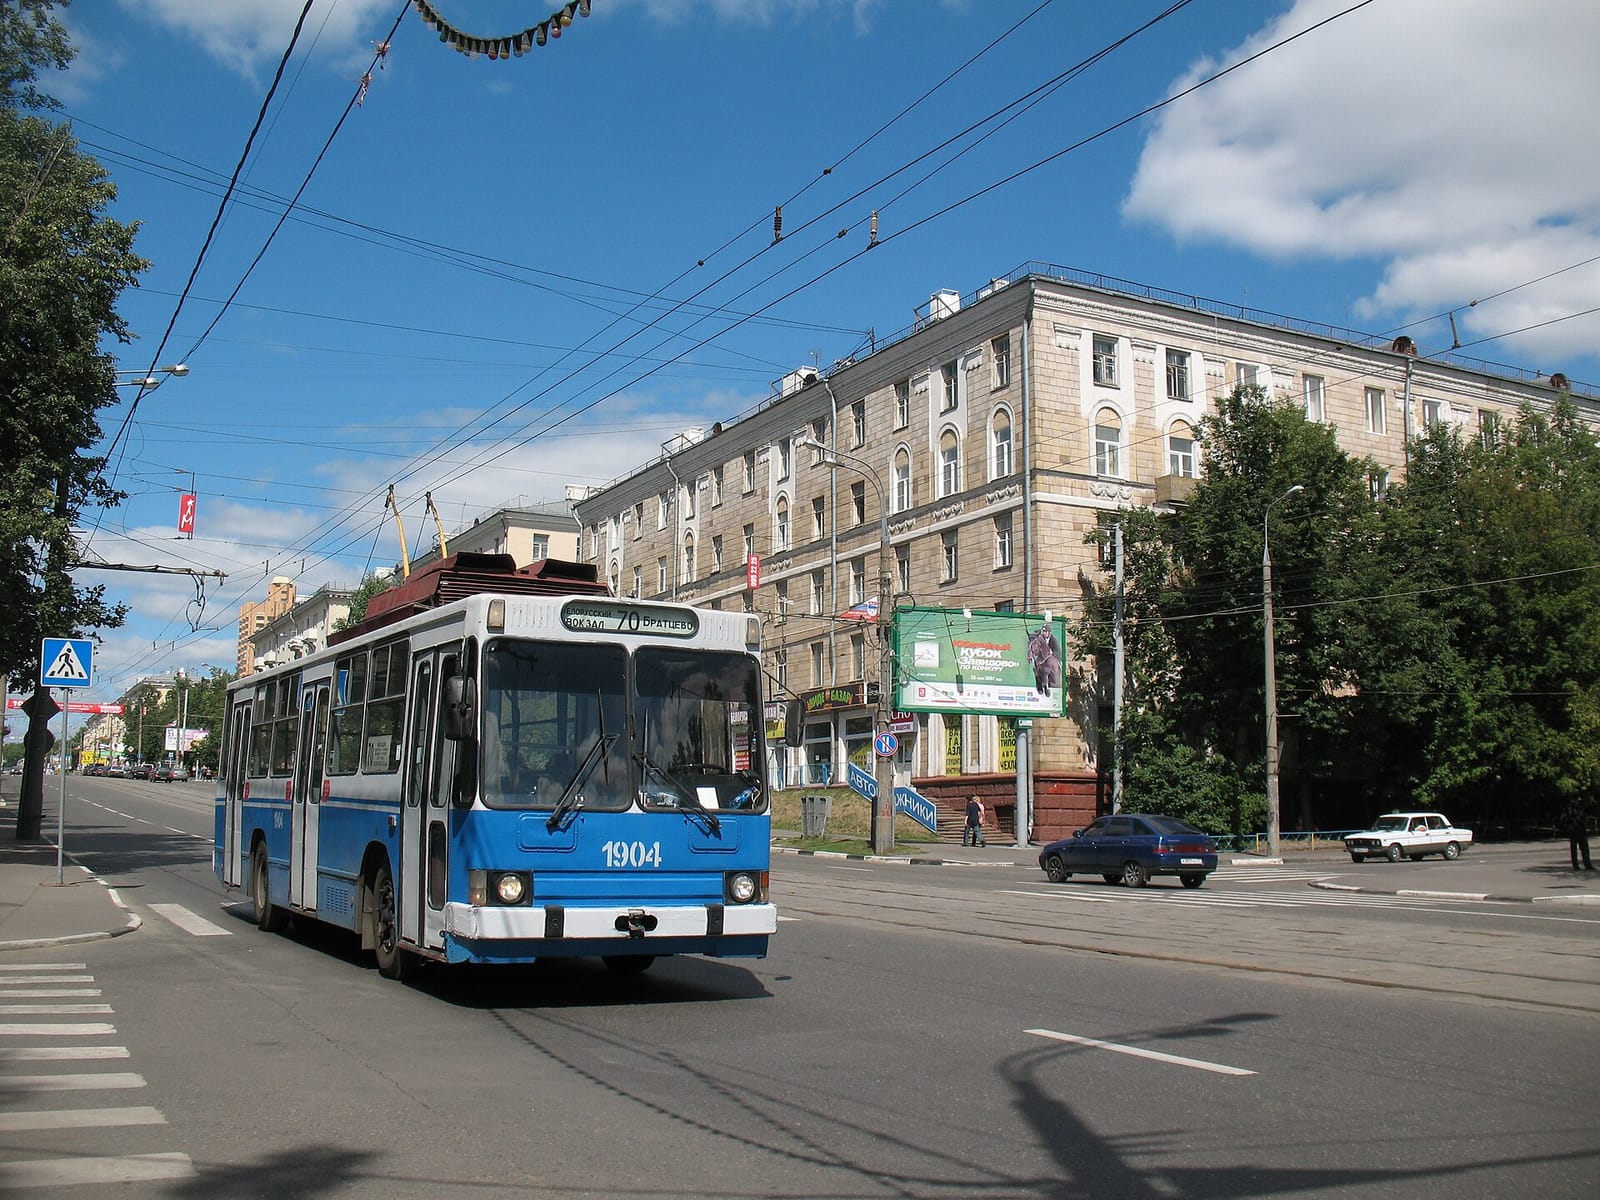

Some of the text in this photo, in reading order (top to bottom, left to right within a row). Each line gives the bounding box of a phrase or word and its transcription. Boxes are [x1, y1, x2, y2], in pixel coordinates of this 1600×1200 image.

[566, 607, 612, 618] ЕЛОРУССКИЙ
[566, 617, 605, 630] ВОКЗАЛ
[616, 610, 640, 631] 70
[643, 616, 693, 630] БРАТЦЕВО
[602, 840, 662, 868] 1904
